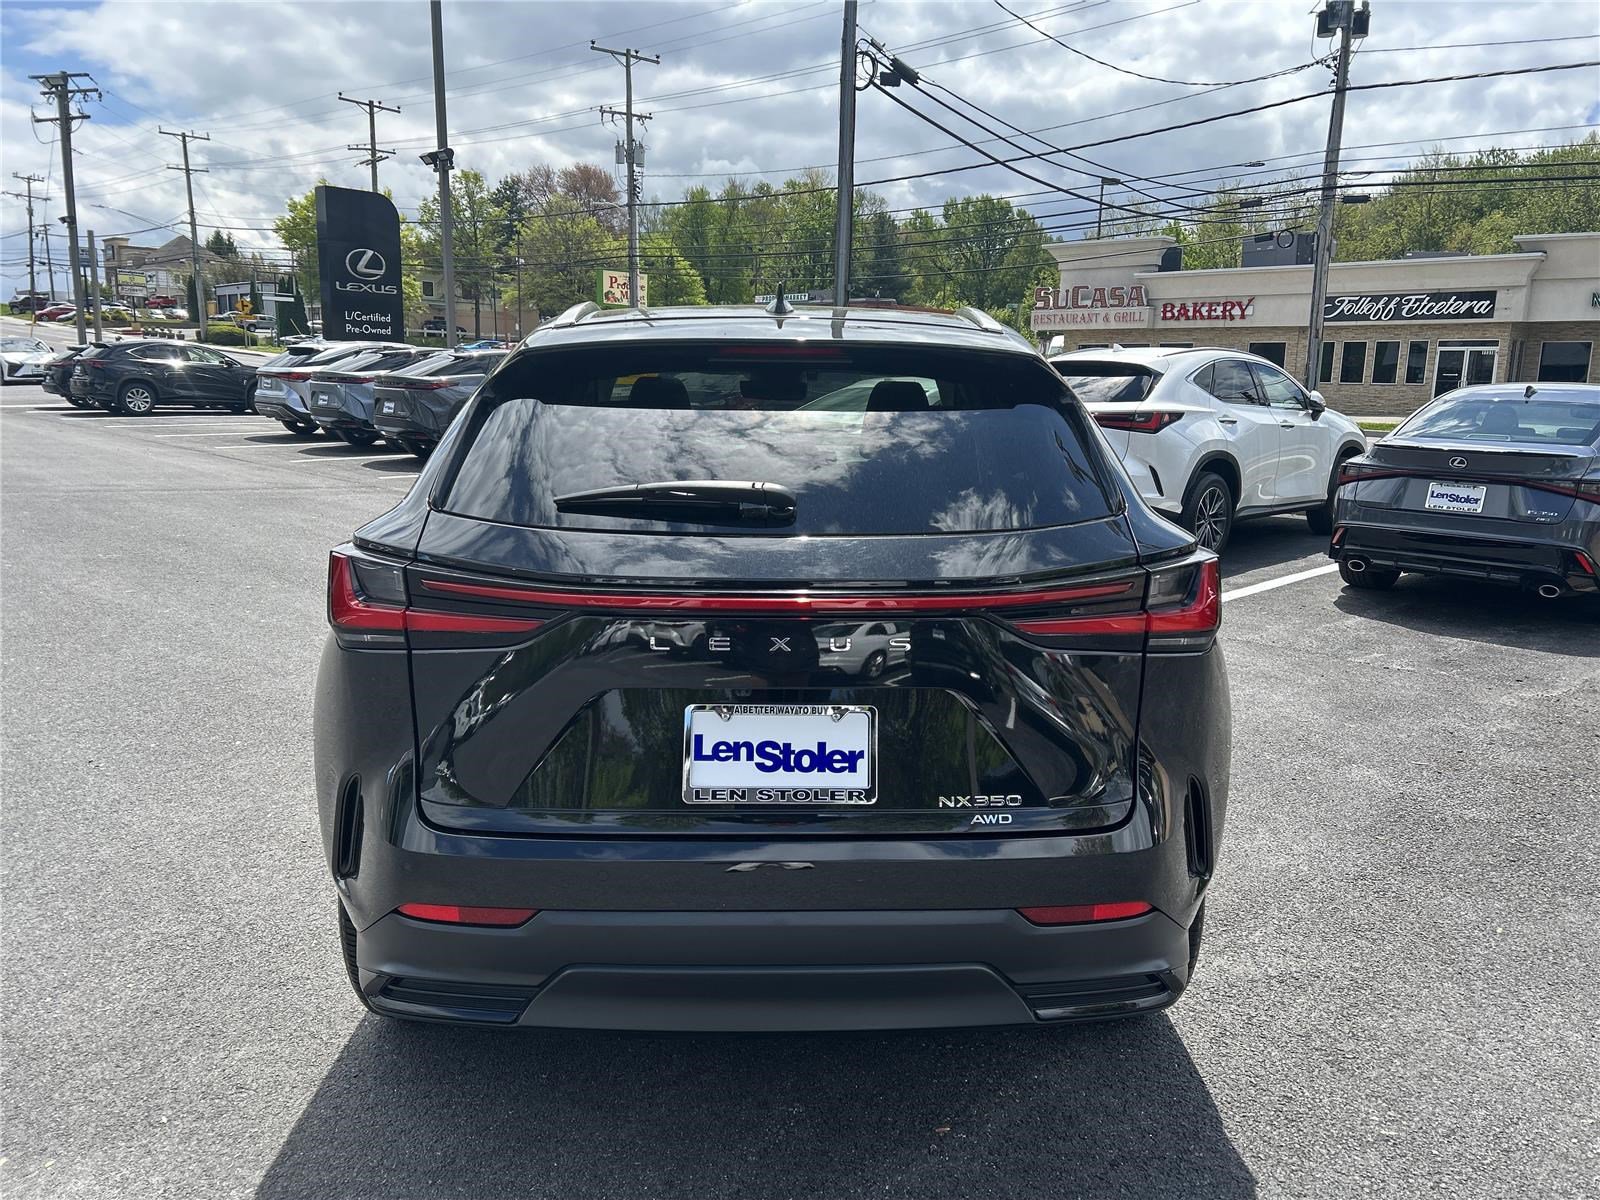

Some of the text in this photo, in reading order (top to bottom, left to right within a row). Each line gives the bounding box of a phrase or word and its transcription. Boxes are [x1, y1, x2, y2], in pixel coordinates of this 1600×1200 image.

[335, 281, 397, 295] LEXUS
[1161, 297, 1254, 321] BAKERY
[1401, 294, 1493, 317] Etcetera
[345, 310, 391, 322] L/Certified
[1033, 311, 1144, 325] RESTAURANT & GRILL
[345, 323, 392, 335] Pre-Owned
[650, 636, 911, 652] LEXUS
[734, 705, 829, 716] A BETTER WAY TO BUY
[693, 788, 867, 803] LEN STOLER
[970, 813, 1013, 825] AWD
